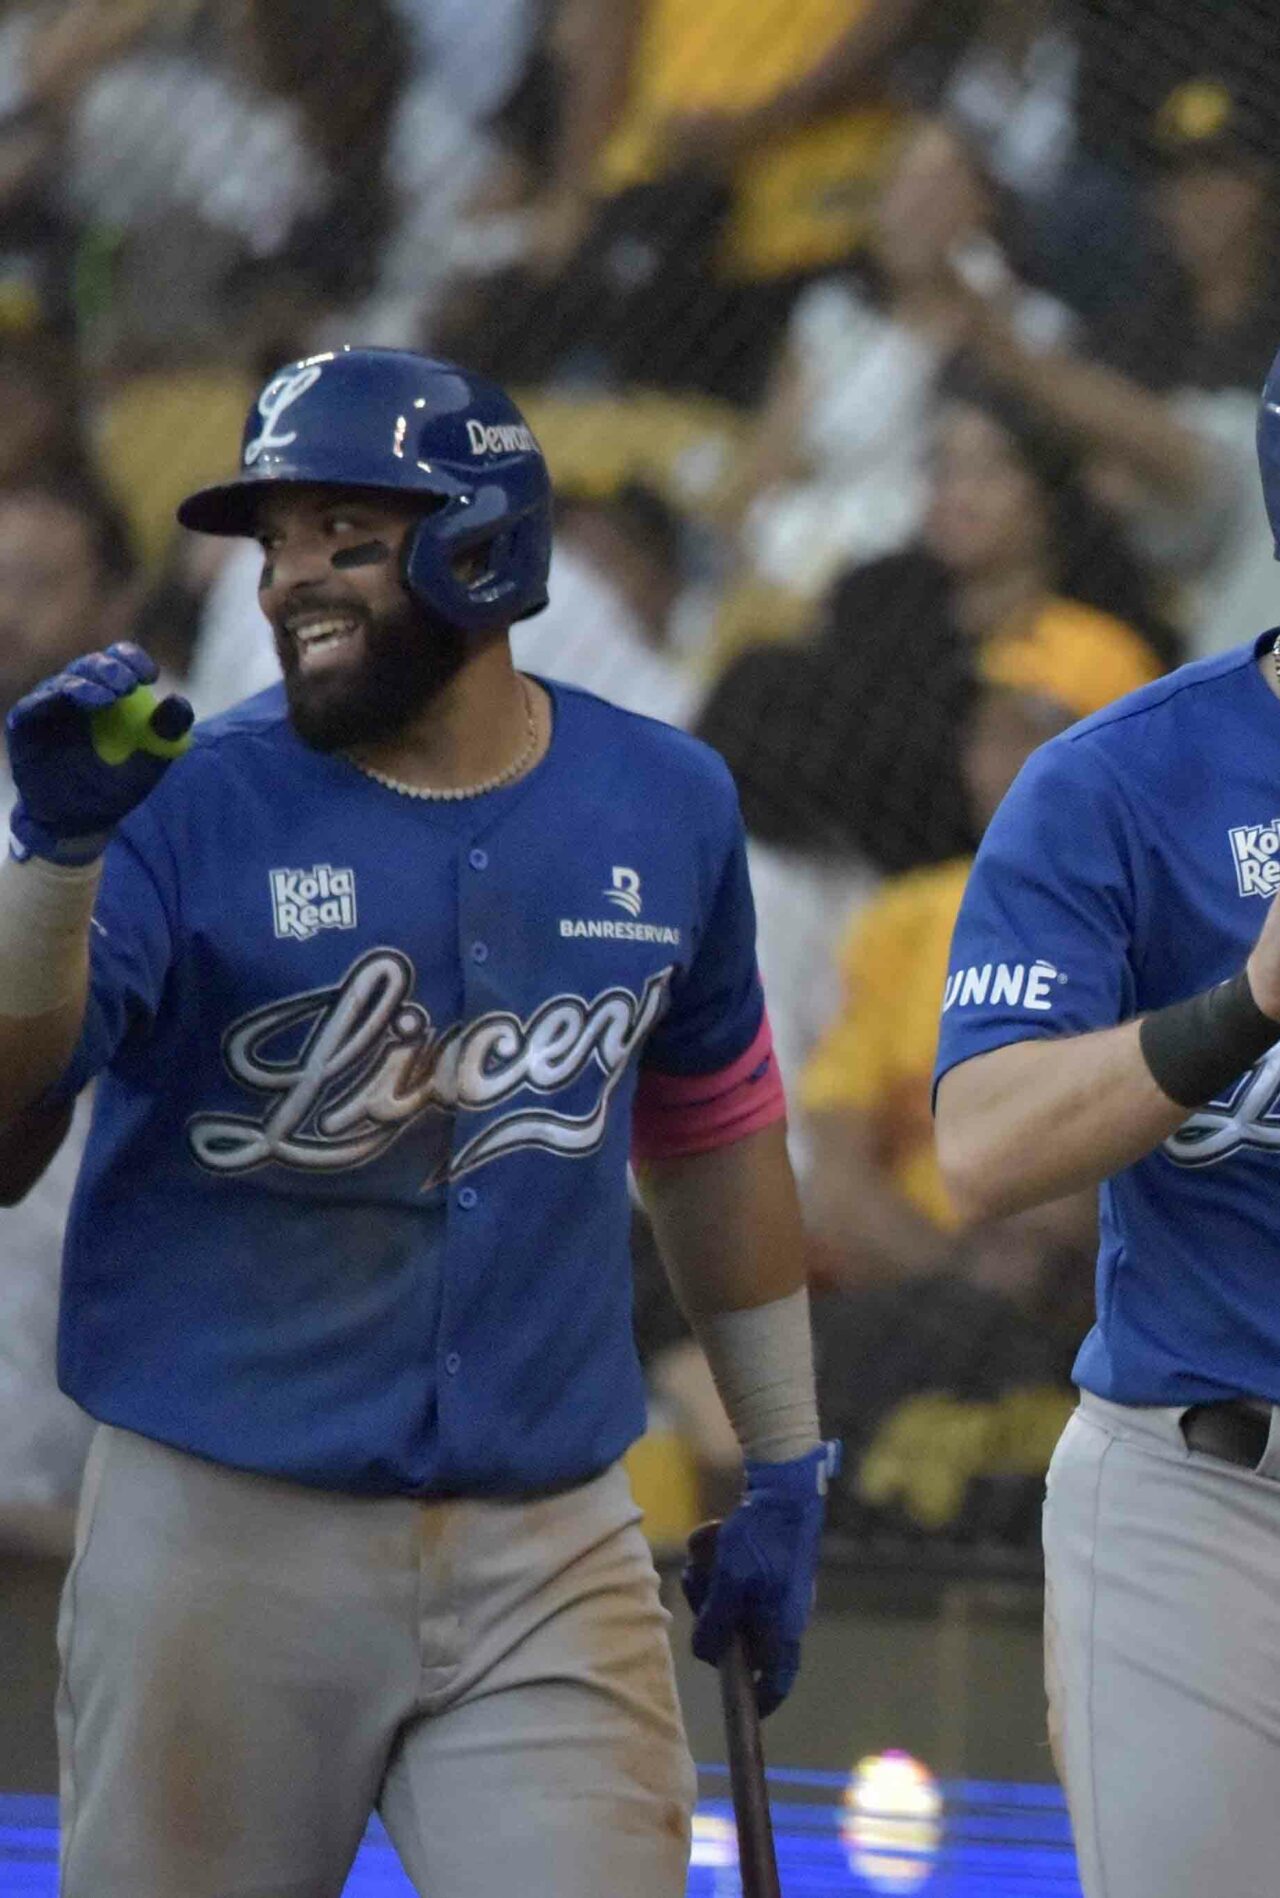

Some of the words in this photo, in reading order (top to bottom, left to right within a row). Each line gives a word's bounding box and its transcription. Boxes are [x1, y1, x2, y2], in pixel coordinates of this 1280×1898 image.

[245, 366, 322, 464] L
[275, 869, 352, 907] Kola
[279, 895, 352, 936] Real
[186, 947, 673, 1192] Licey
